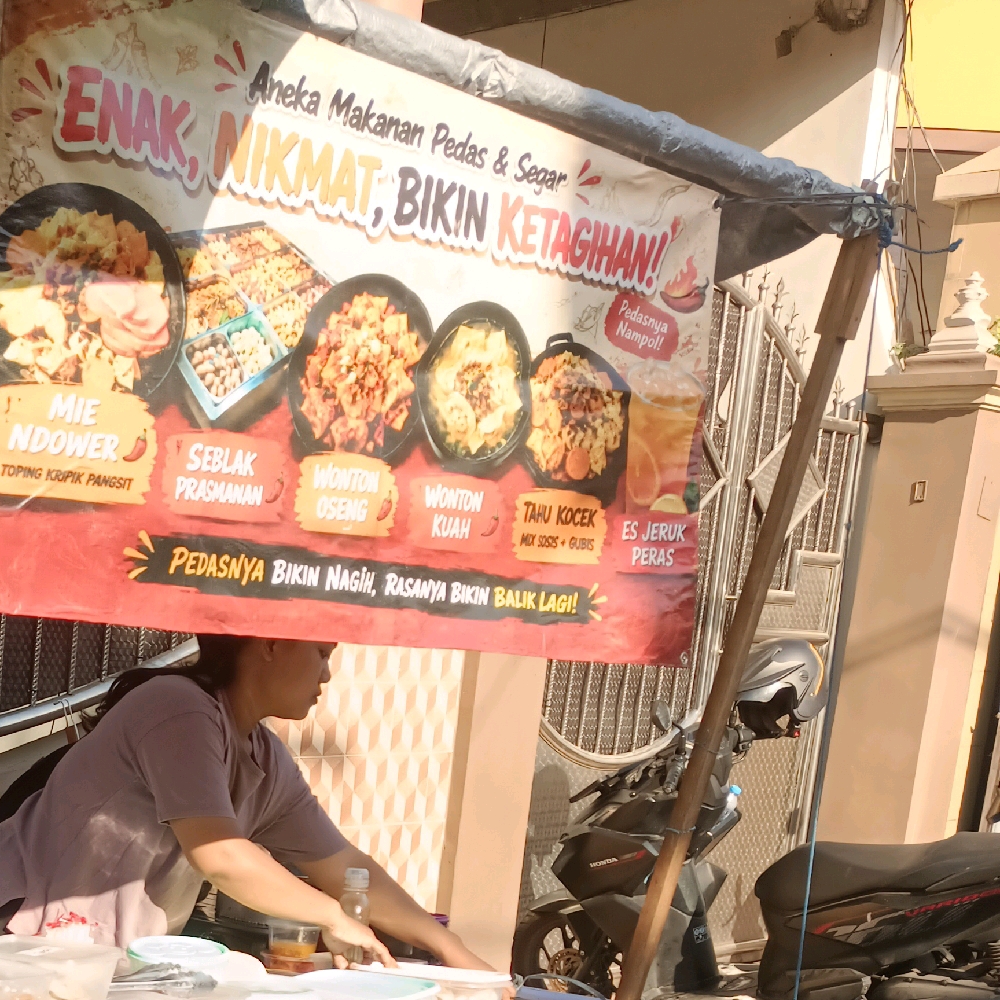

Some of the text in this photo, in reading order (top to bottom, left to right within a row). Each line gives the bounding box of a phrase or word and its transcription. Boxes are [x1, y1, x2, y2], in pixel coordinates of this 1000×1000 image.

[249, 61, 568, 195] Aneka Makanan Pedas & Segar
[61, 65, 669, 290] ENAK, NIKMAT, BIKIN KETAGIHAN!
[617, 299, 669, 334] Pedasnya
[615, 320, 664, 351] Nampol!
[48, 393, 101, 426] MIE
[7, 423, 120, 462] NDOWER
[186, 442, 259, 477] SEBLAK
[0, 463, 43, 480] TOPING
[85, 473, 135, 492] PANGSIT
[174, 475, 264, 507] PRASMANAN
[313, 462, 381, 493] WONTON
[316, 495, 369, 523] OSENG
[424, 483, 485, 513] WONTON
[431, 513, 472, 540] KUAH
[523, 501, 598, 528] TAHU KOCEK
[520, 532, 537, 547] MIX
[621, 520, 687, 542] ES JERUK
[631, 546, 675, 567] PERAS
[168, 546, 265, 587] PEDASNYA
[271, 559, 321, 587] BIKIN
[384, 573, 447, 604] RASANYA
[450, 581, 490, 606] BIKIN
[493, 586, 537, 610] BALIK
[538, 591, 579, 614] LAGI!
[589, 857, 619, 868] HONDA
